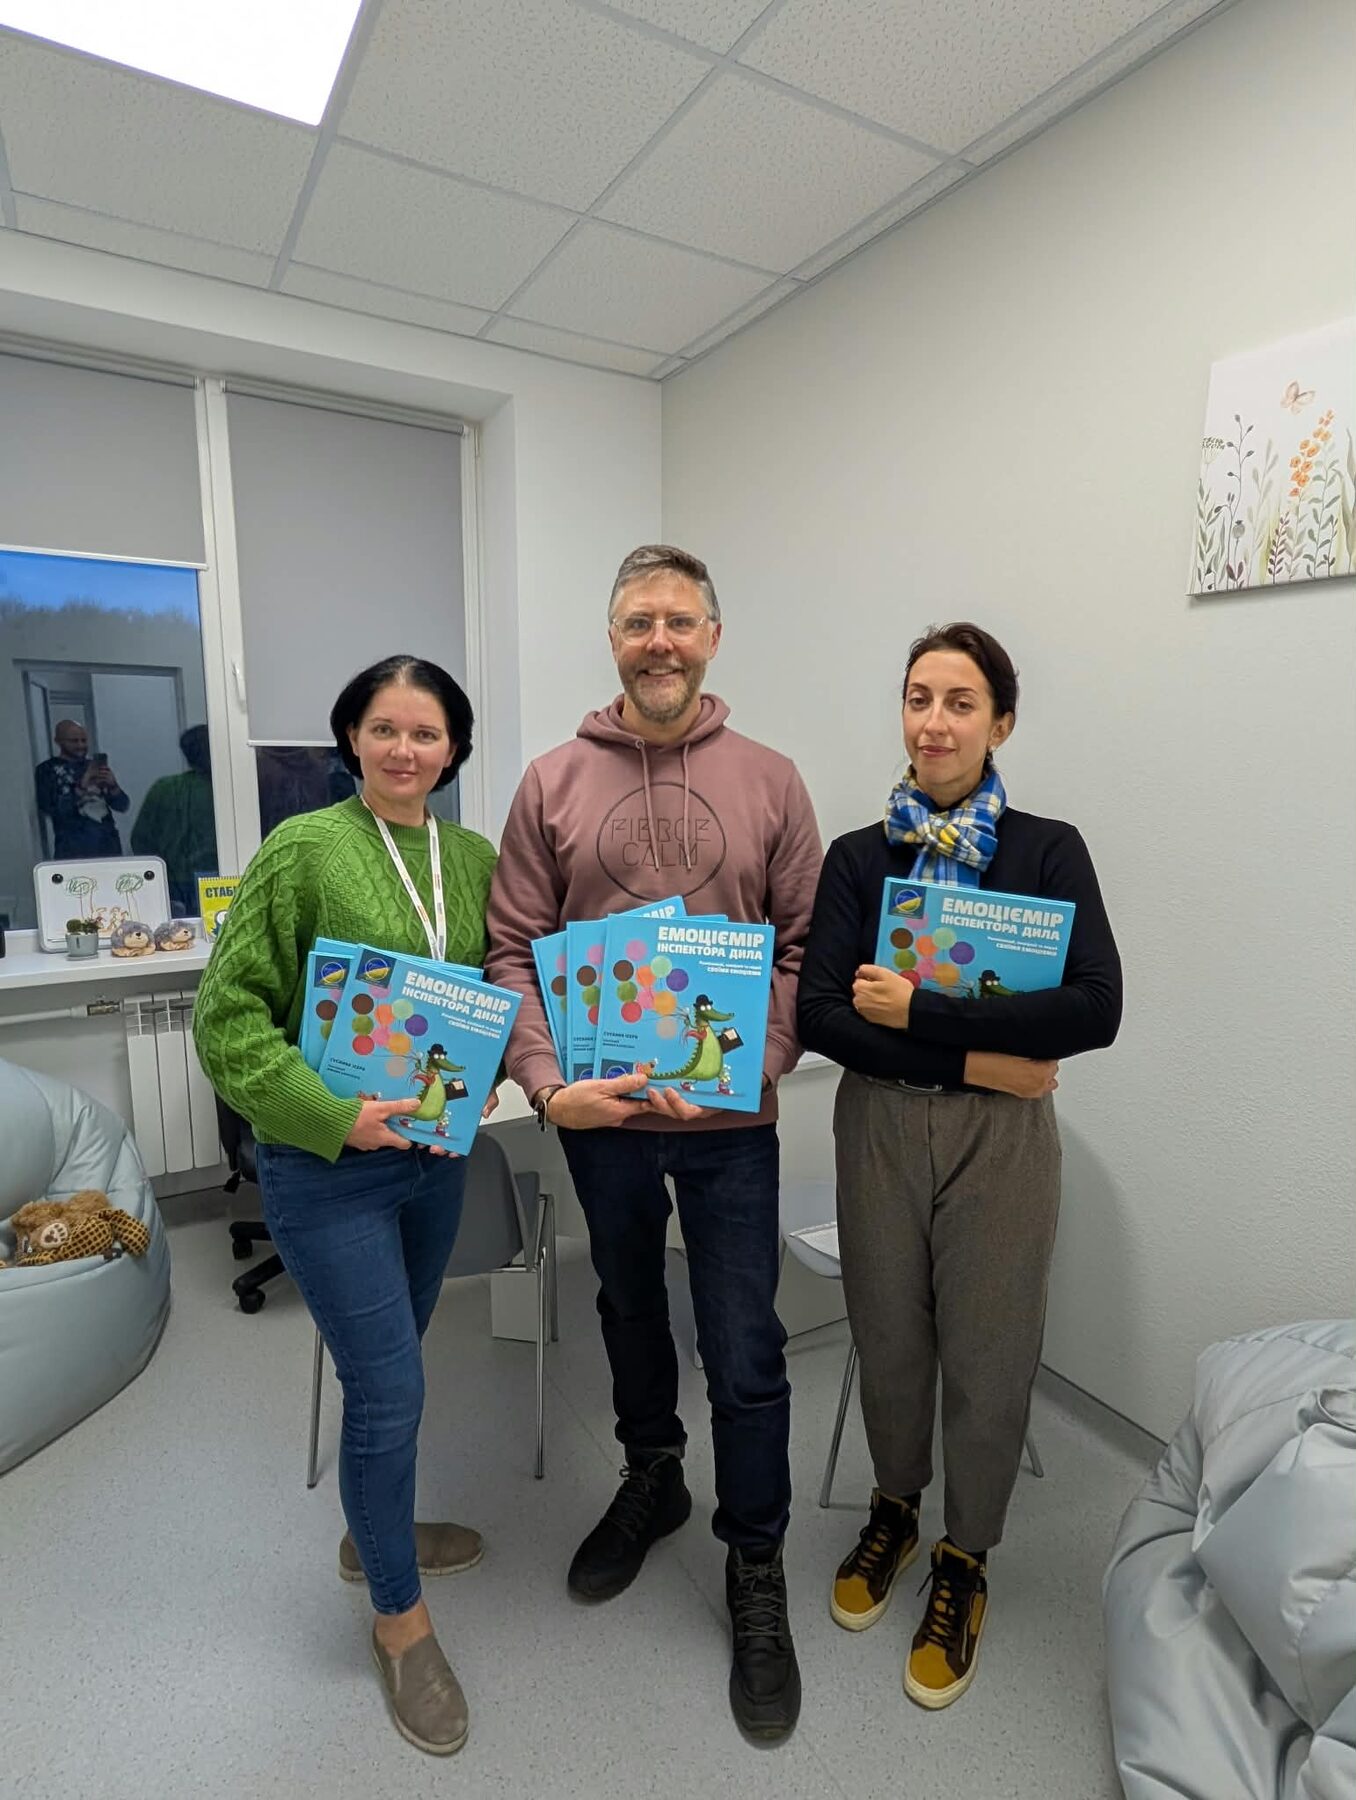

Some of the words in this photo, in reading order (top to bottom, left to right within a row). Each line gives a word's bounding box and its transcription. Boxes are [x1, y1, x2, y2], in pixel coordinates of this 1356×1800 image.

[622, 842, 698, 867] CALM
[942, 897, 1064, 927] ЕМОЦІЄМІР
[658, 926, 765, 948] ЕМОЦІЄМІР
[941, 914, 1018, 934] ІНСПЕКТОРА
[1022, 926, 1060, 941] ДИЛА
[657, 942, 726, 957] ІНСПЕКТОРА
[729, 949, 763, 960] ДИЛА
[404, 970, 511, 1013] ЕМОЦІЄМІР
[402, 986, 470, 1014] ІНСПЕКТОРА
[472, 1008, 505, 1025] ДИЛА
